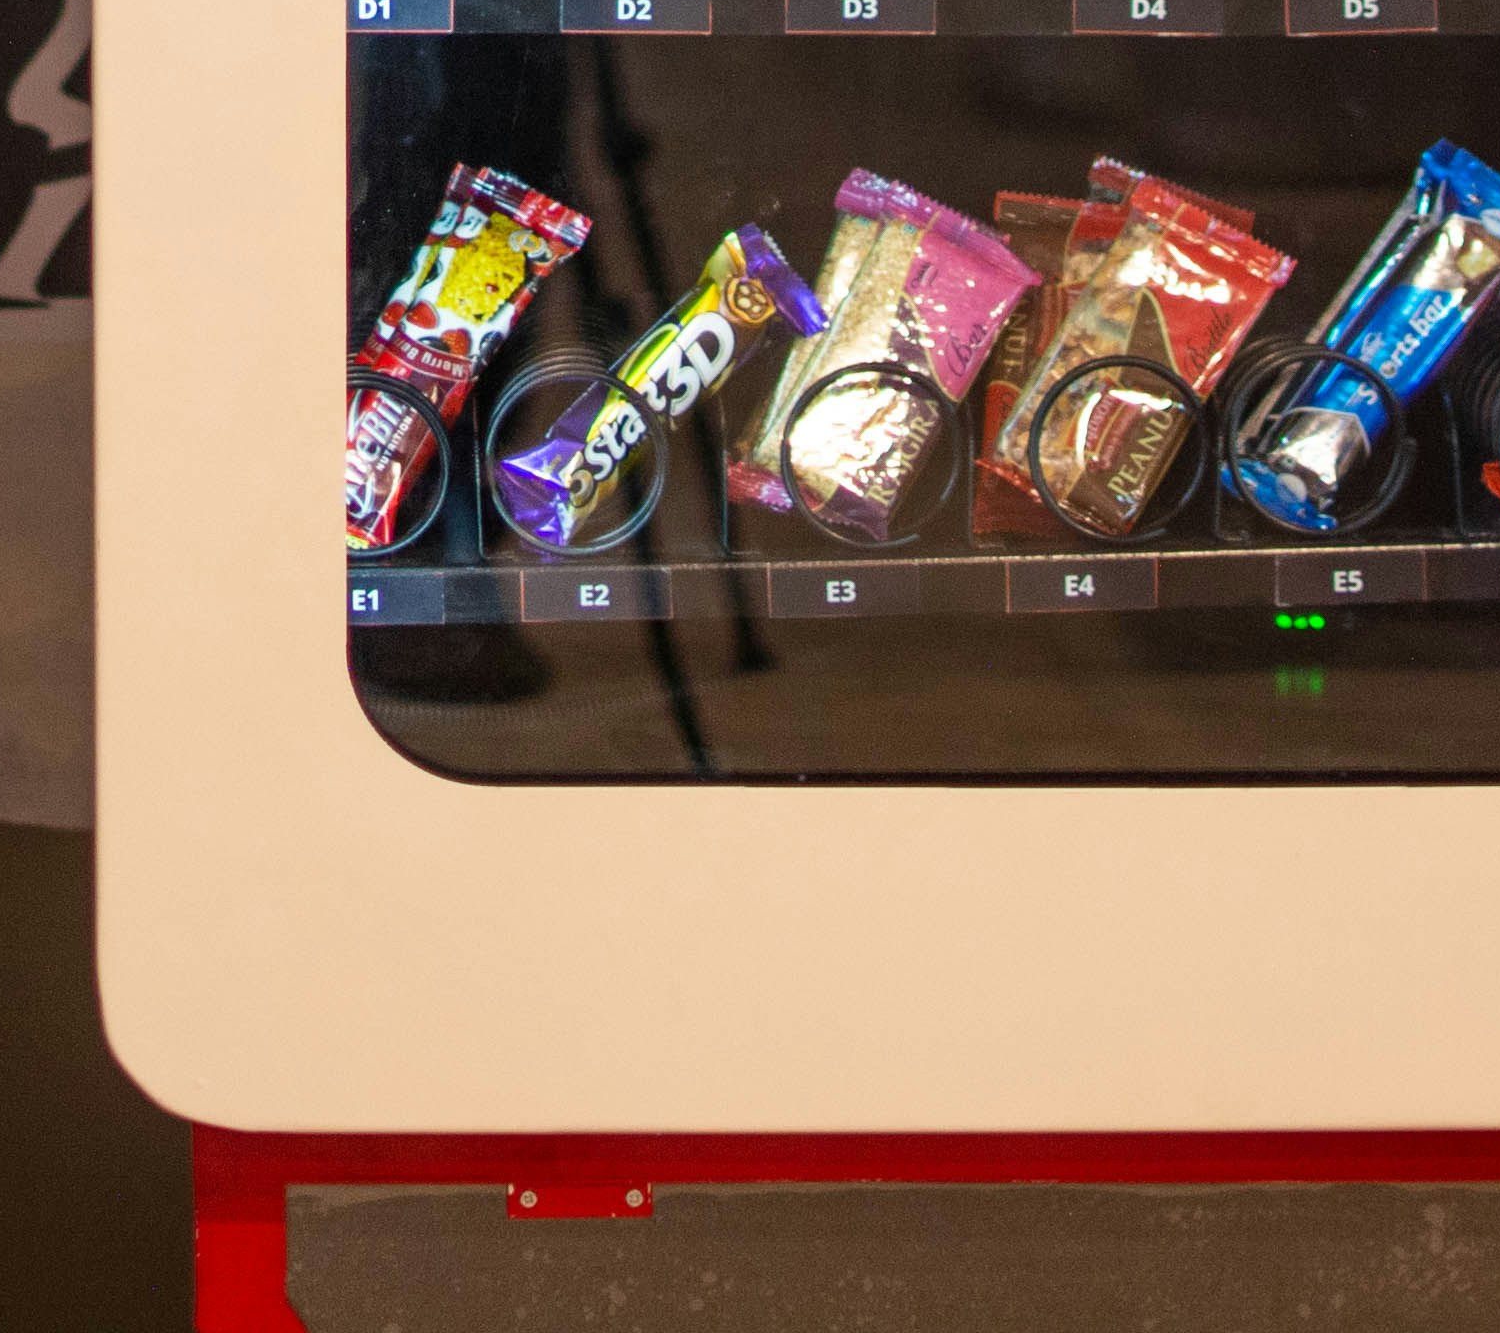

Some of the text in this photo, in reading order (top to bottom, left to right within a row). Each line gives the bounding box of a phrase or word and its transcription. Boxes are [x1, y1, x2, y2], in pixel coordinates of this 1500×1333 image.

[1362, 293, 1446, 406] Sorts bar
[375, 414, 414, 472] NUTRITION
[1105, 399, 1182, 501] PEANU
[825, 580, 857, 603] E3
[1063, 574, 1095, 597] E4
[1333, 571, 1364, 592] E5
[352, 590, 381, 611] E1
[579, 584, 610, 607] E2
